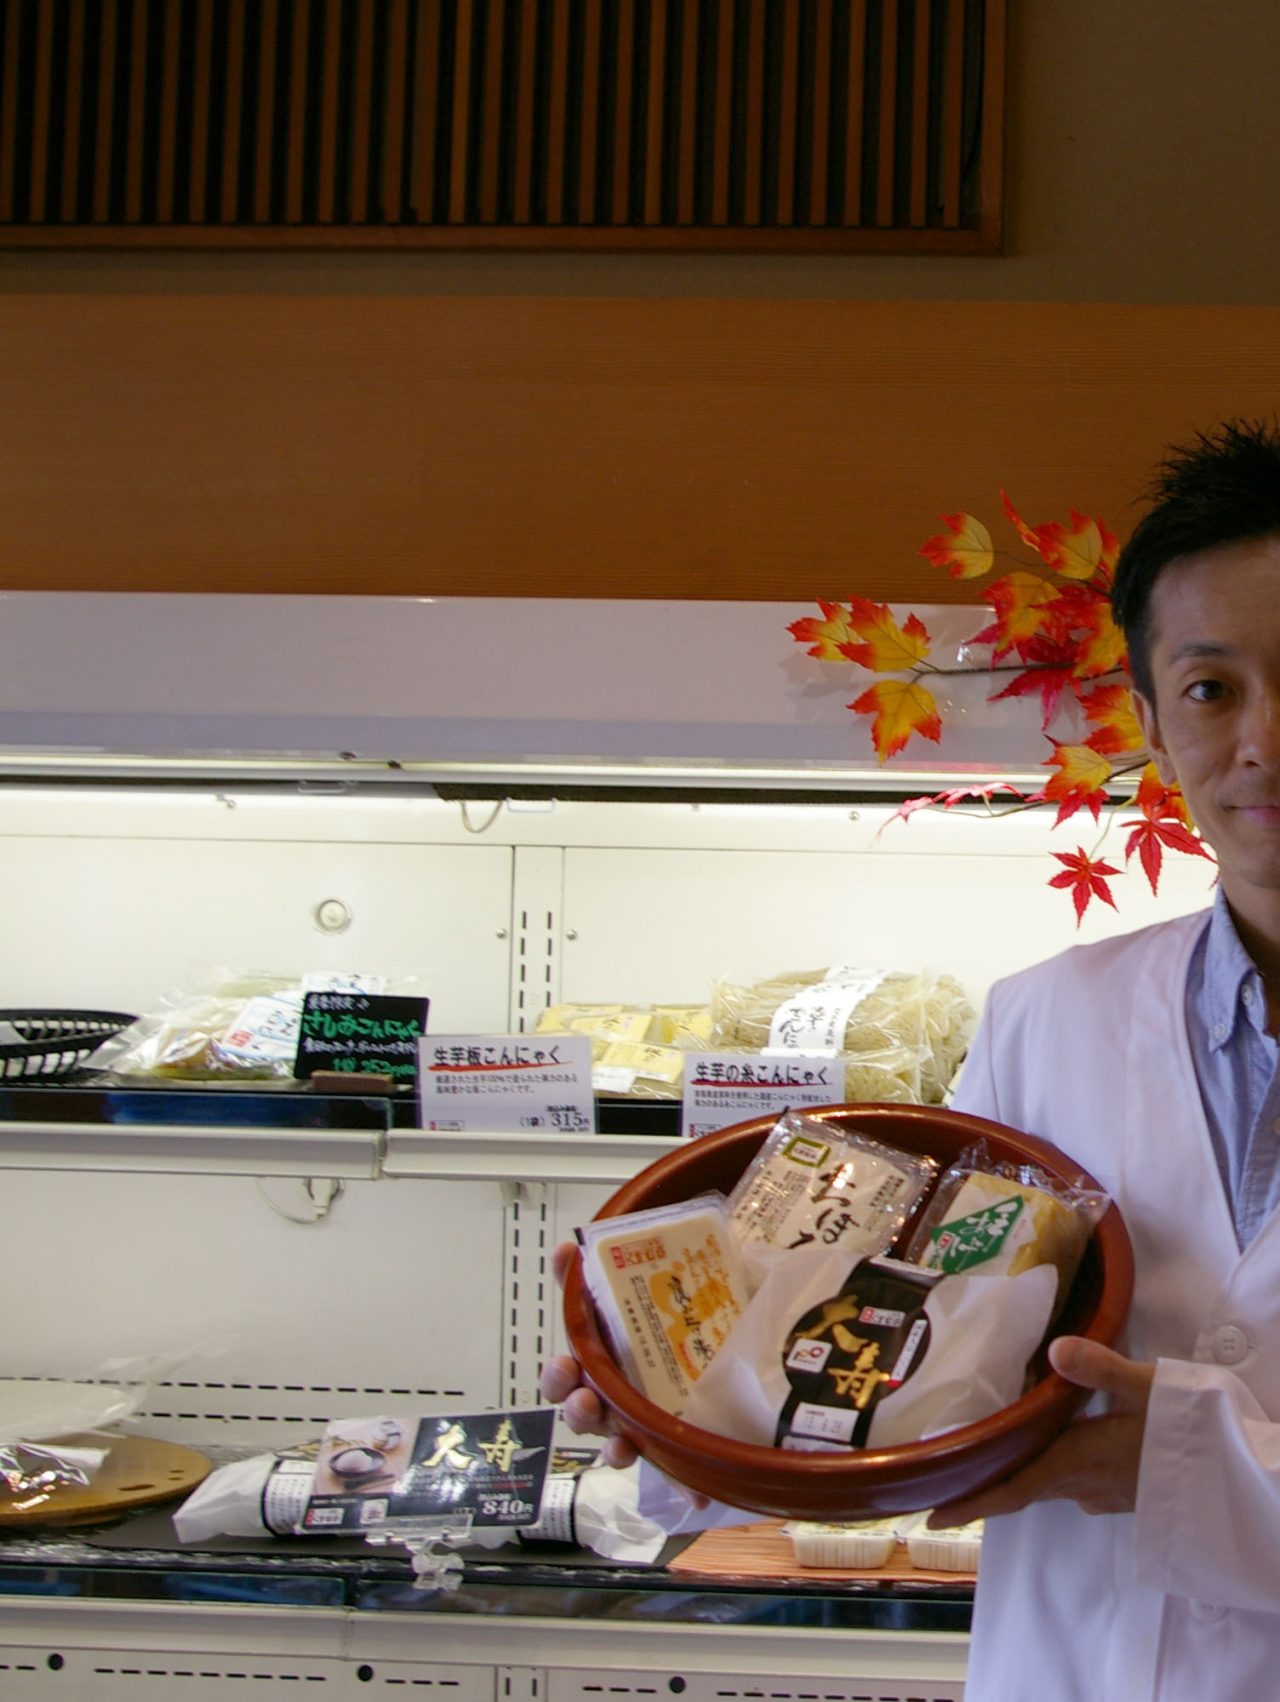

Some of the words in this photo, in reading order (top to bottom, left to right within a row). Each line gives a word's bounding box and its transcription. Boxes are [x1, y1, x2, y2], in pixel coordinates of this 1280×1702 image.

[434, 1045, 561, 1066] 生芋板こんにゃく
[695, 1060, 828, 1085] 生芋の糸こんにゃく
